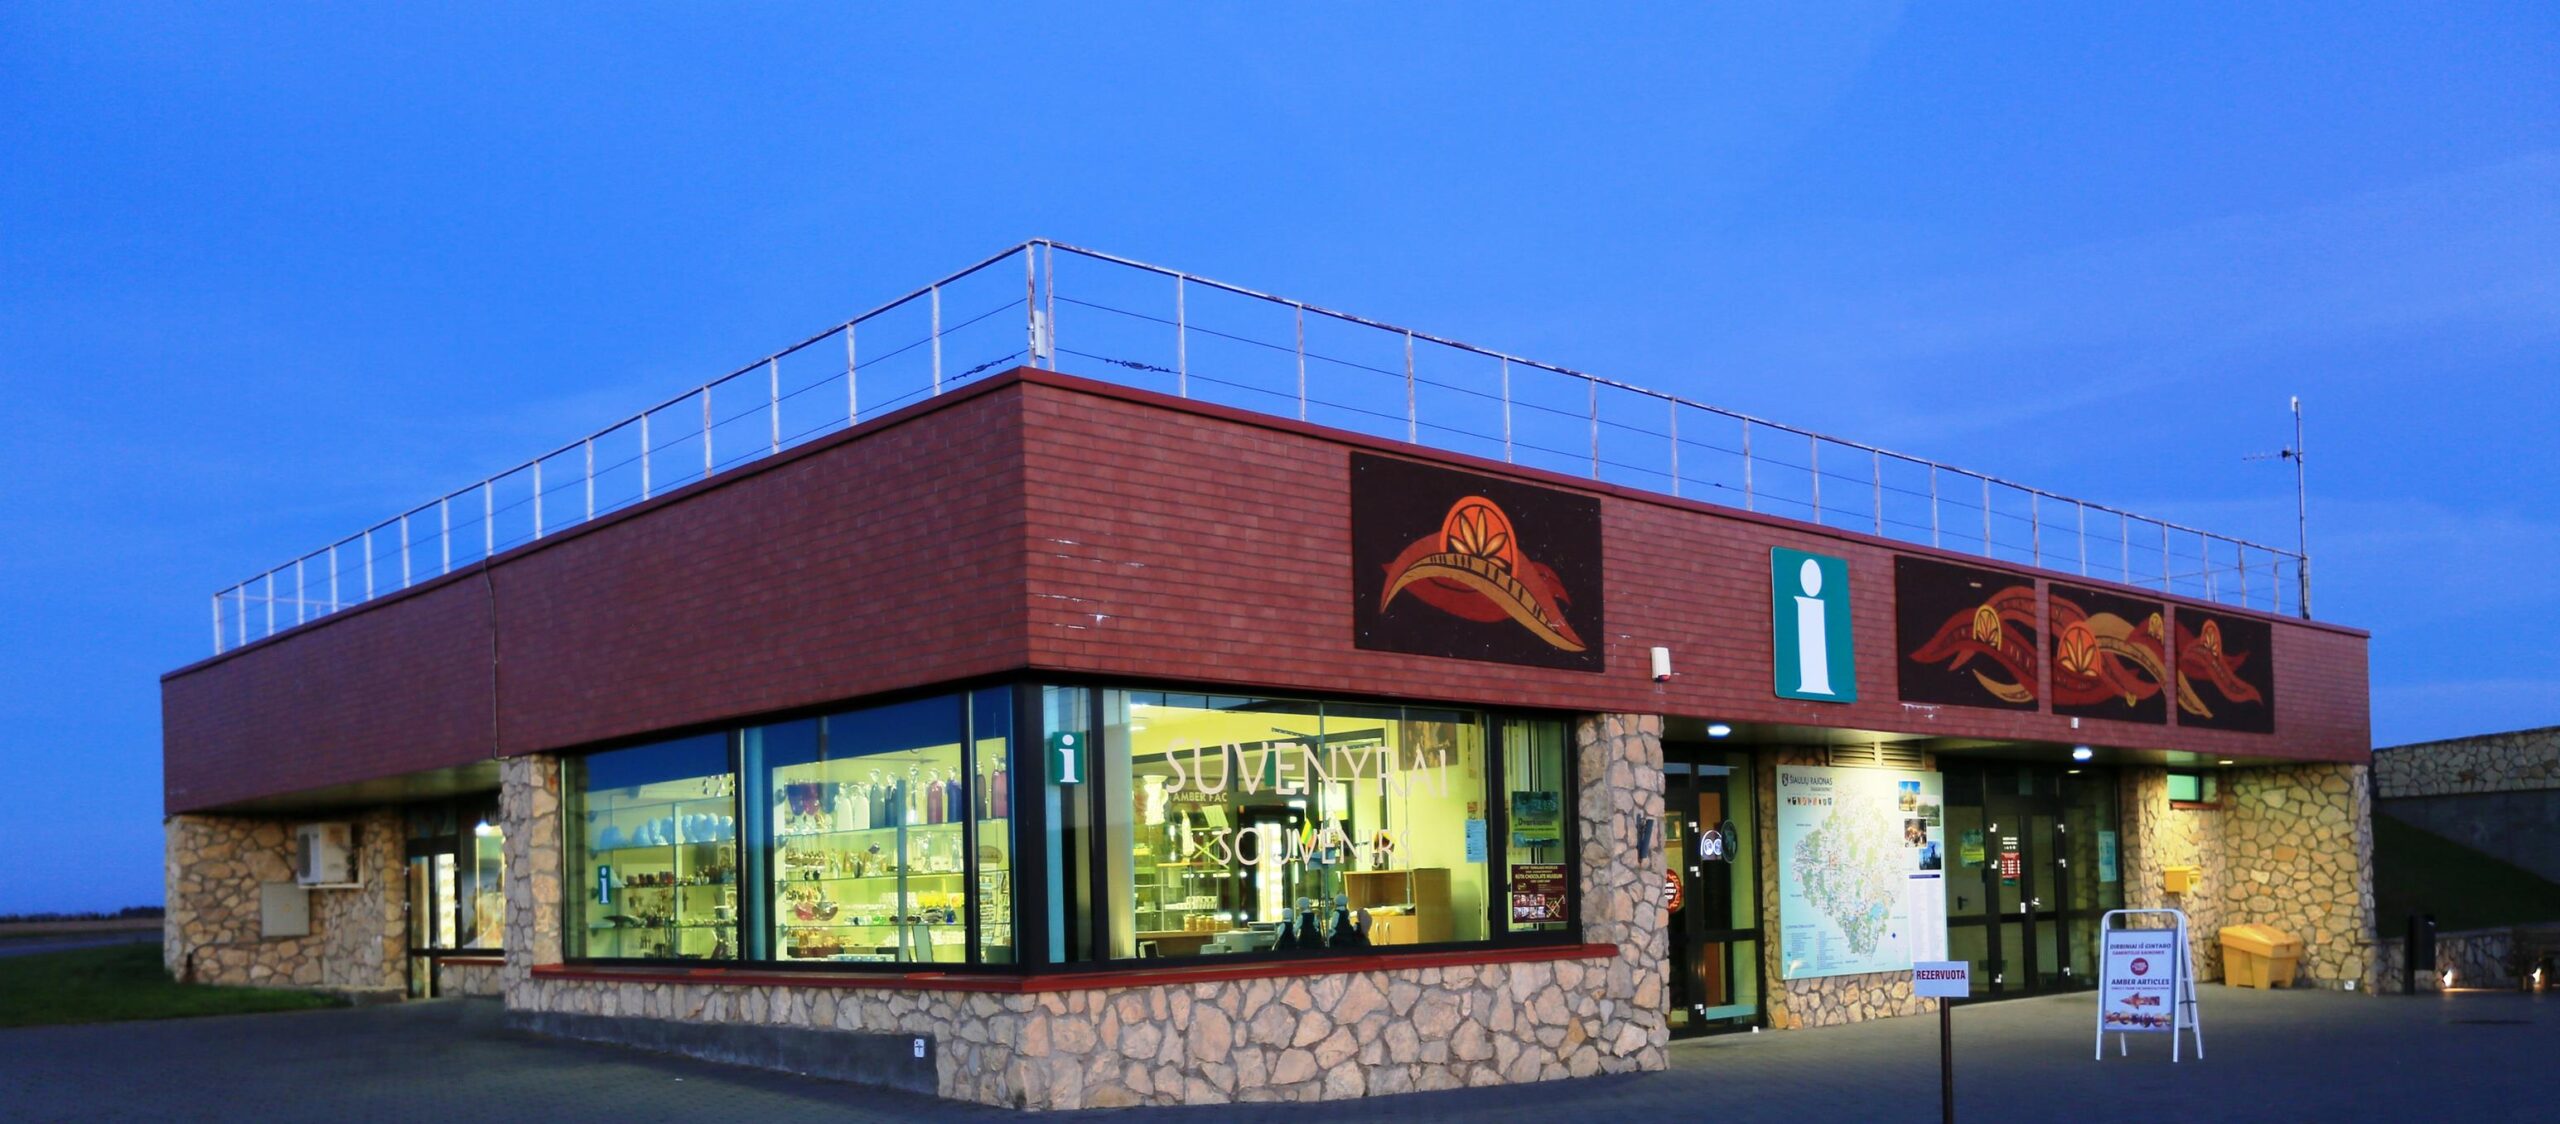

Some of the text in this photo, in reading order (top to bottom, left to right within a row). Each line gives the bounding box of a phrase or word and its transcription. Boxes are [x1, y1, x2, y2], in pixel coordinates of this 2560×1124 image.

[1793, 558, 1836, 696] i
[1166, 737, 1448, 800] SUVENYRAI
[1172, 791, 1207, 802] AMBER
[1217, 826, 1412, 872] SOUVENIRS
[1916, 969, 1966, 980] REZERVUOTA
